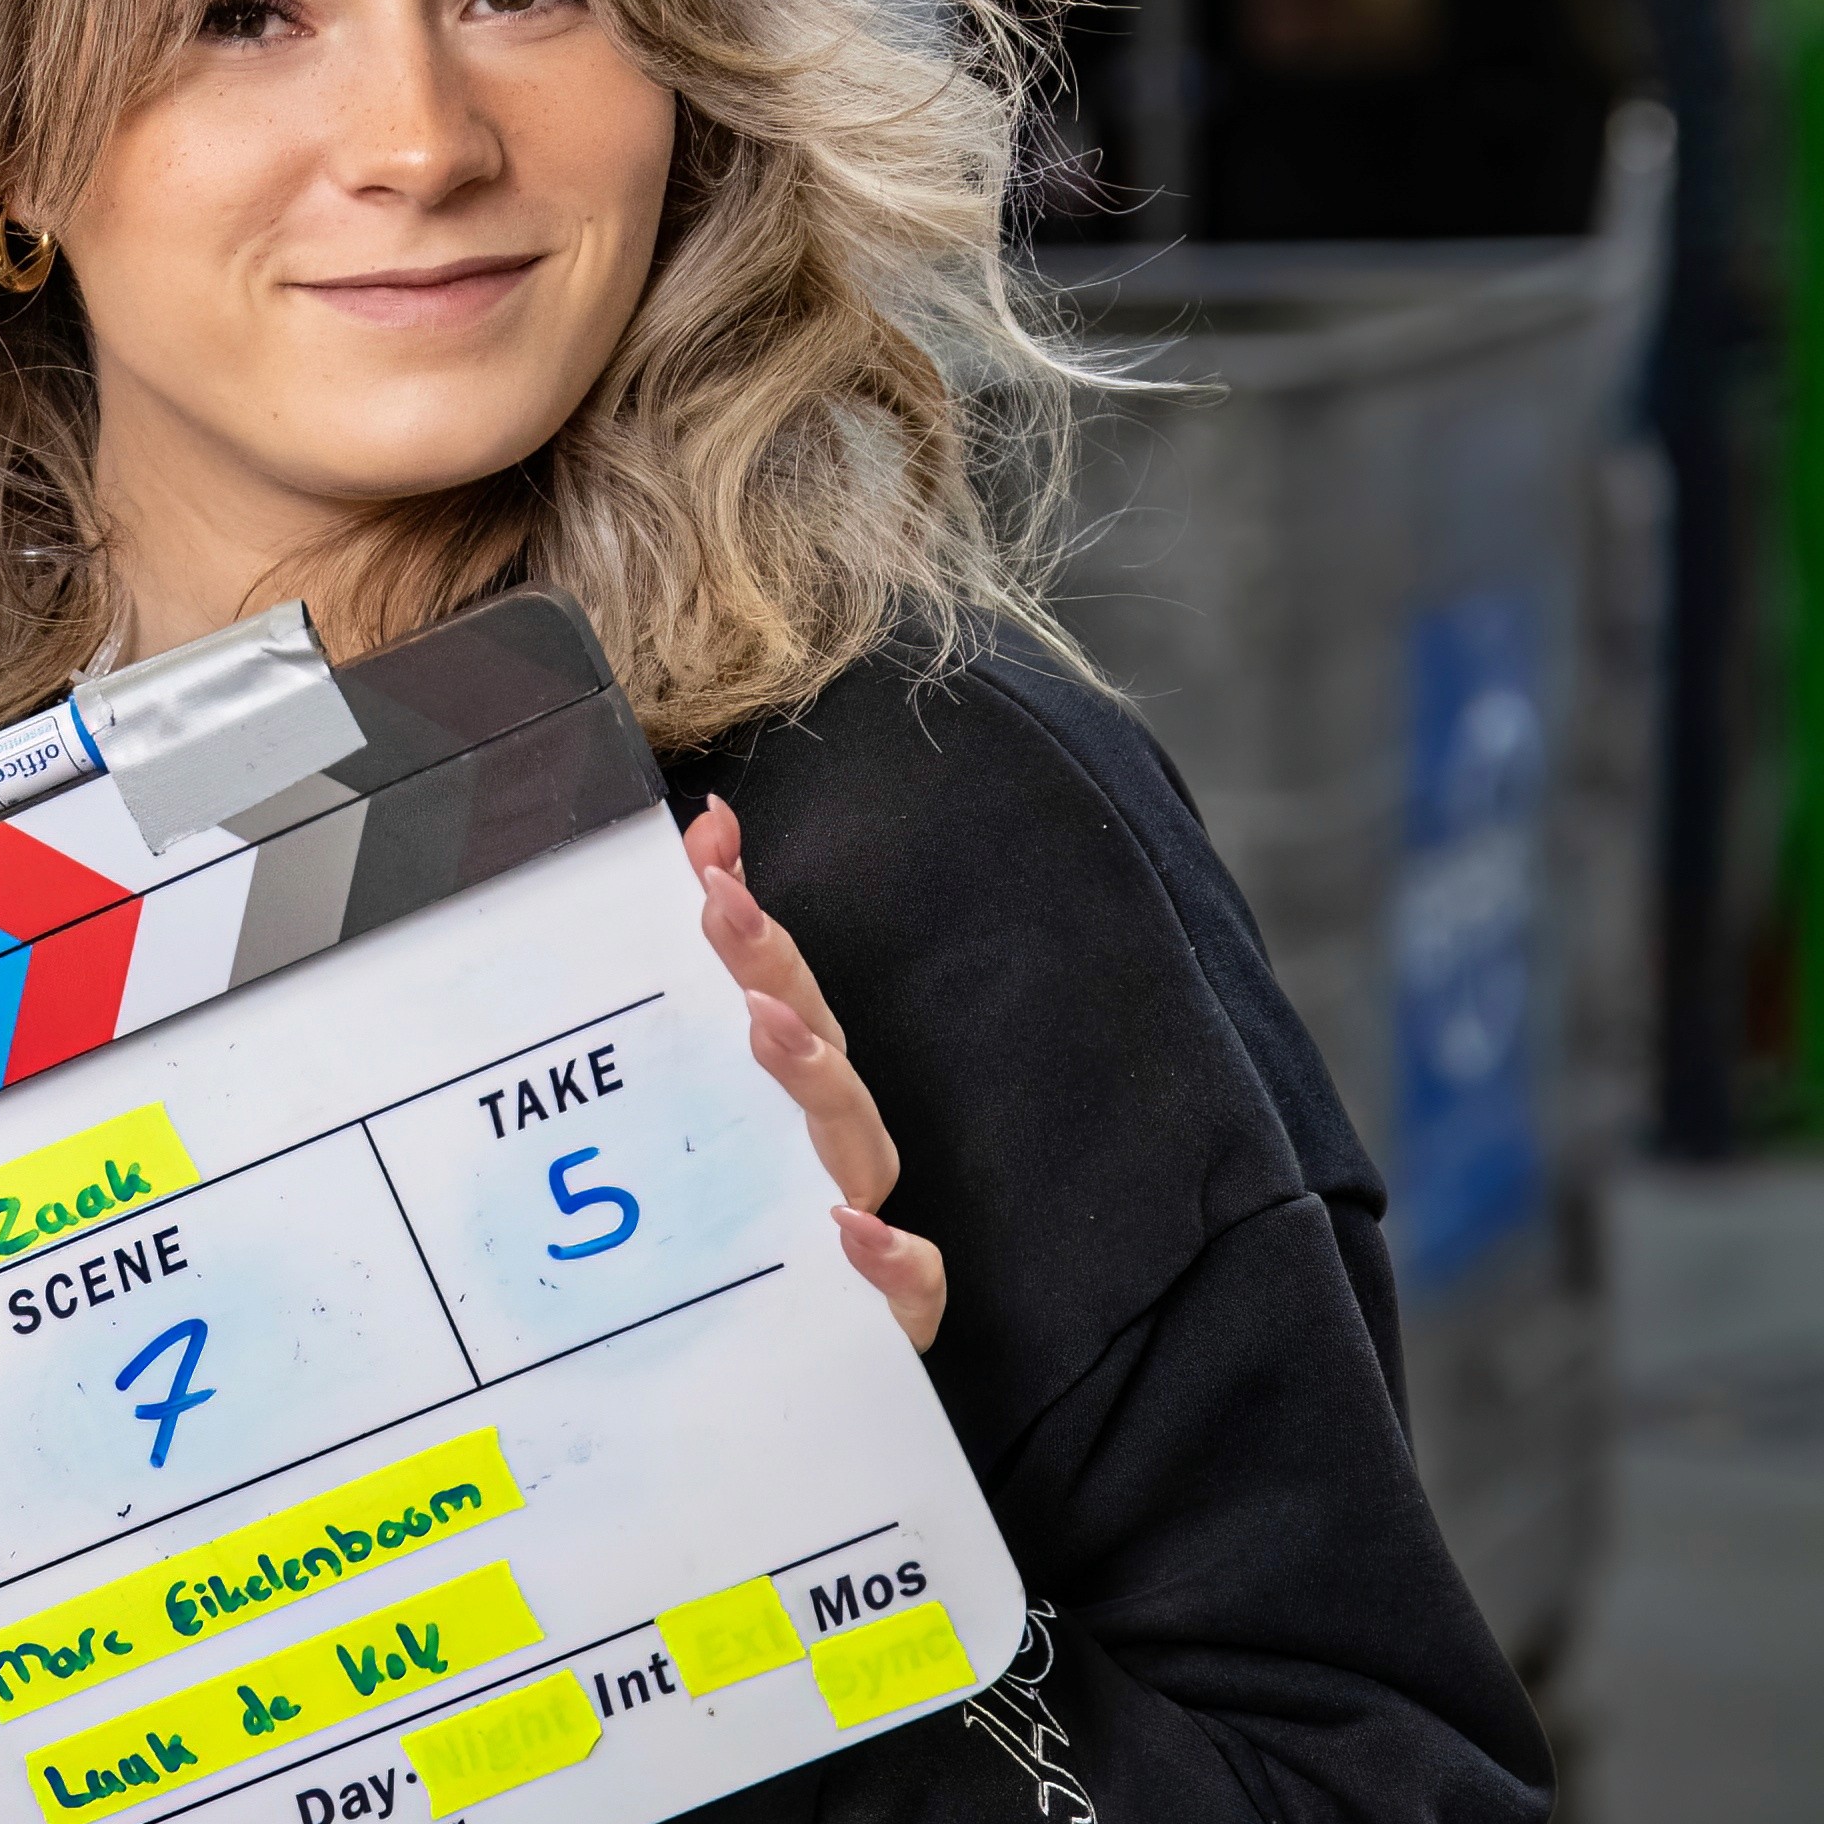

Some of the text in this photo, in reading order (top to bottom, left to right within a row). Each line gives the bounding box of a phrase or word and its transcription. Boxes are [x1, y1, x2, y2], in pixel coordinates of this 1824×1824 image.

[479, 1042, 625, 1140] TAKE
[547, 1146, 641, 1261] 5
[8, 1225, 189, 1334] SCENE
[115, 1318, 218, 1469] 7
[593, 1653, 675, 1719] Int
[809, 1560, 928, 1632] Mos
[236, 1685, 301, 1736] de
